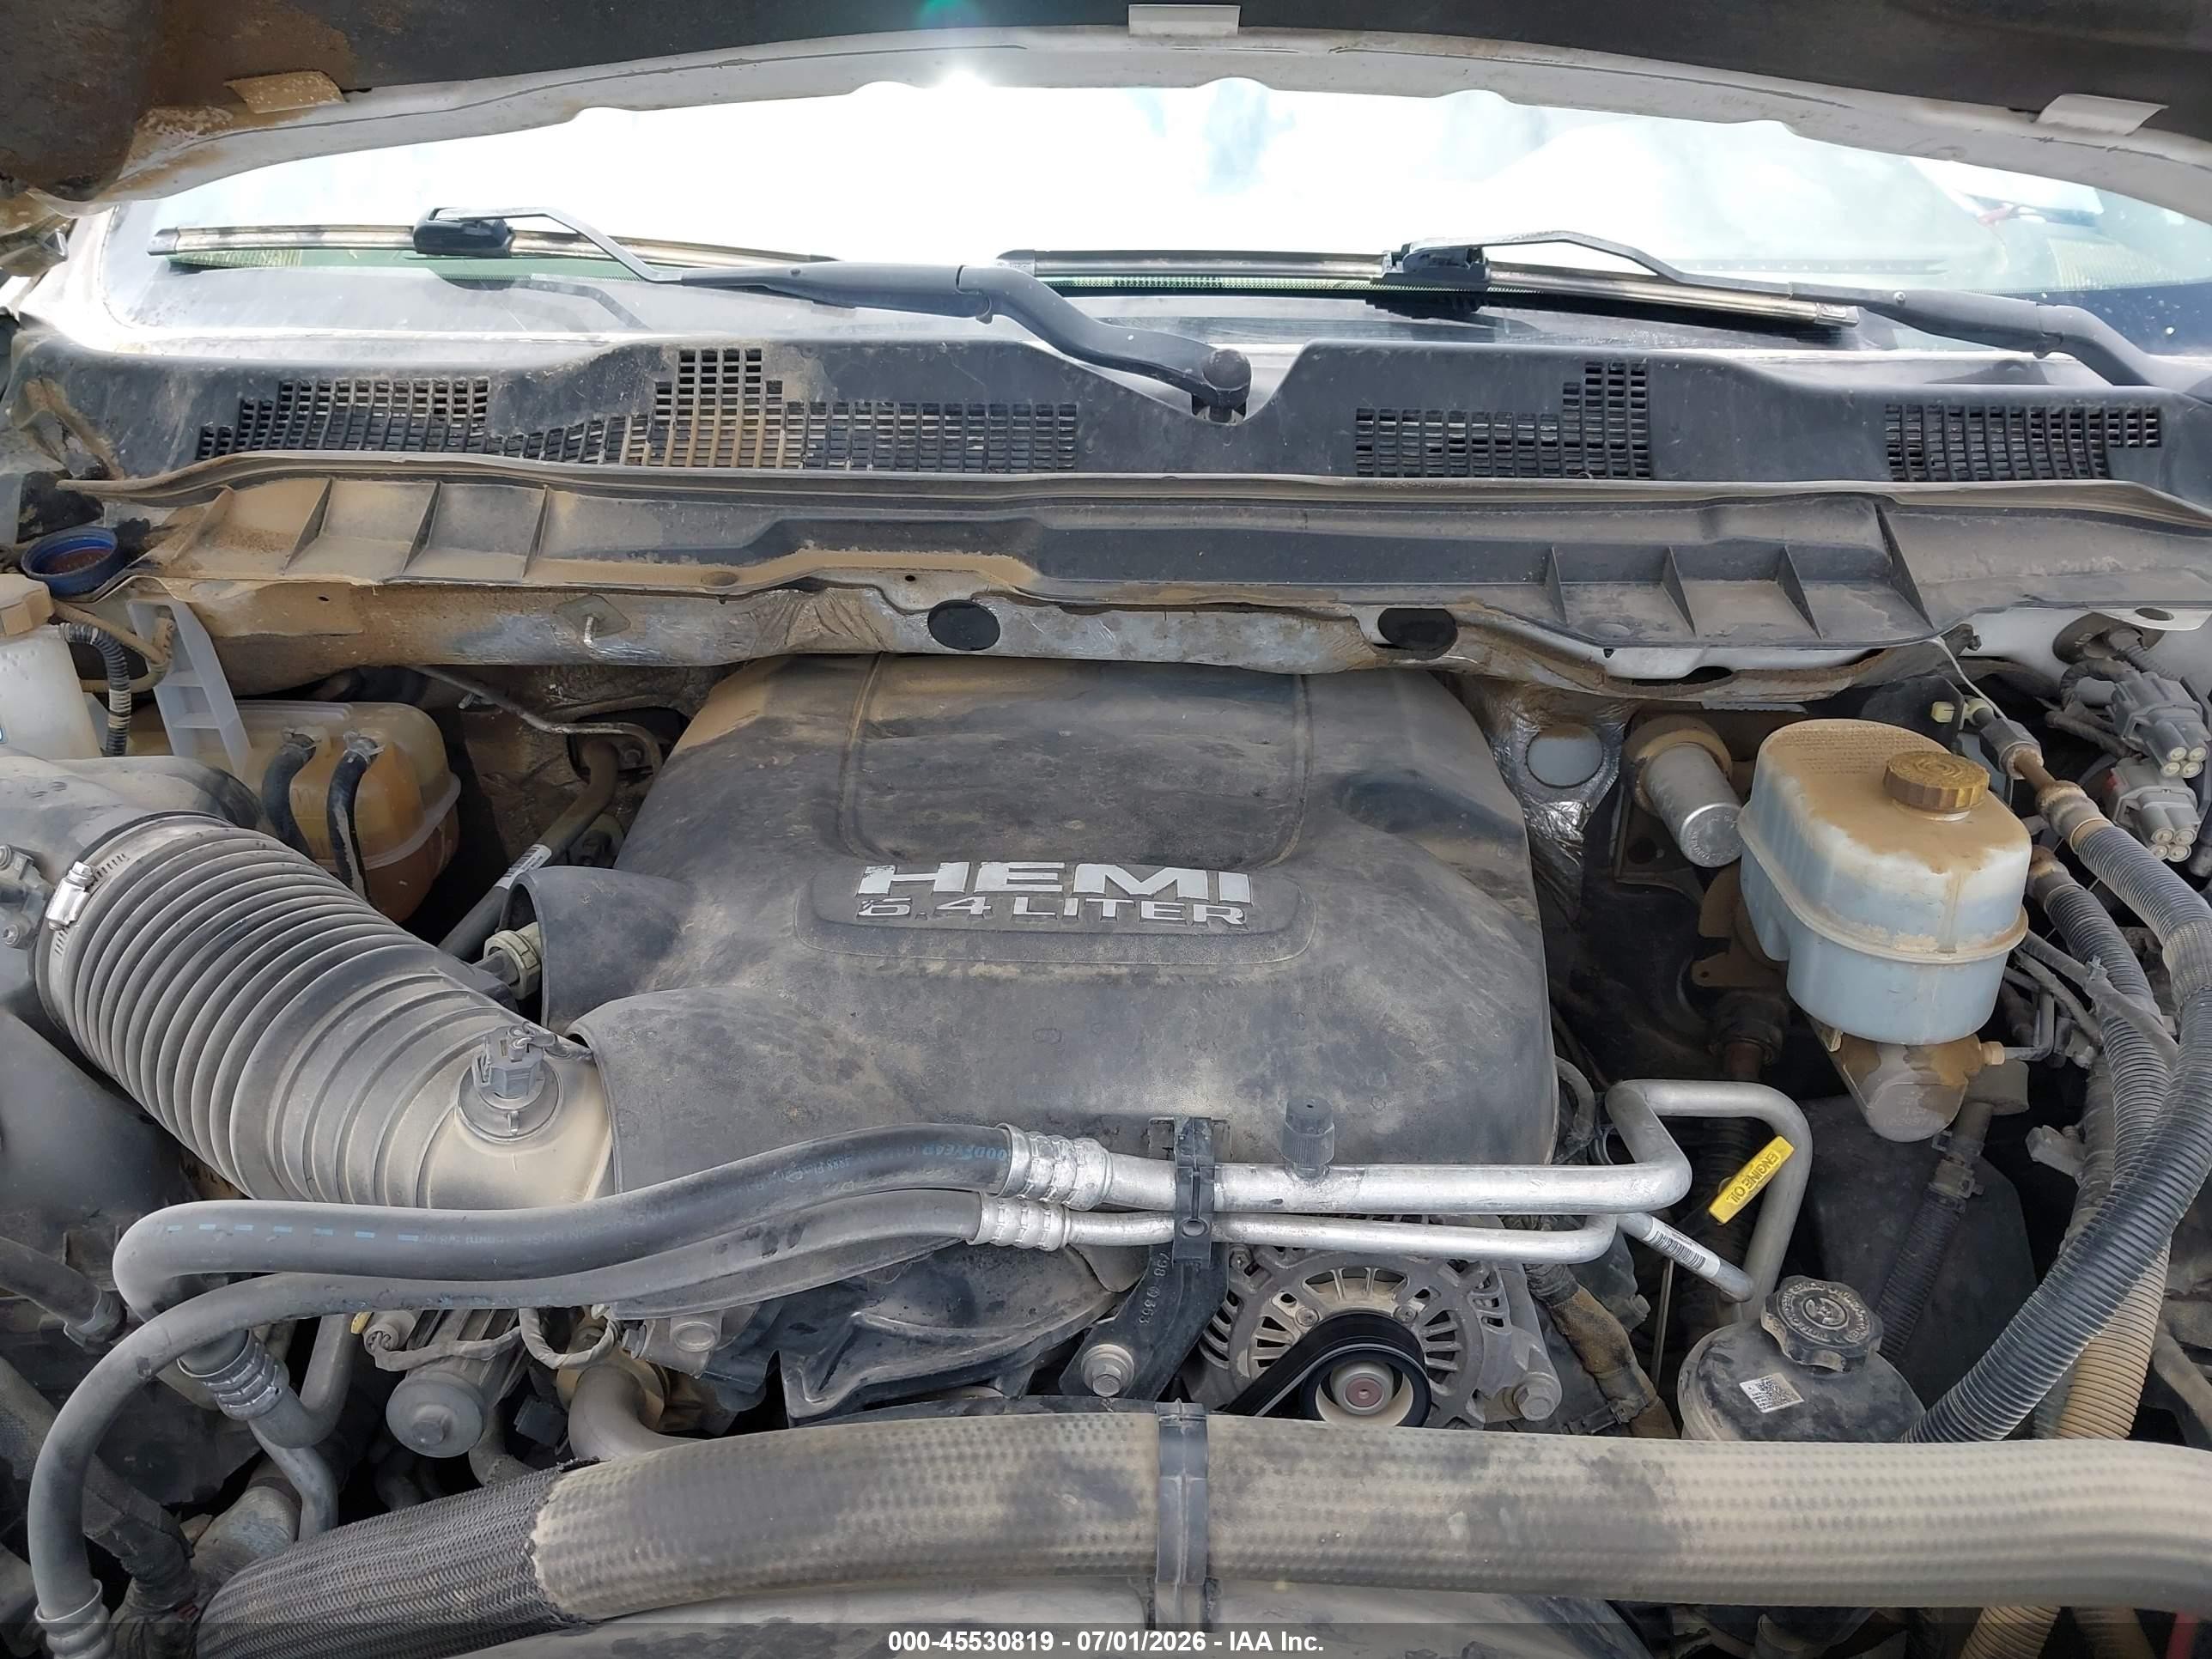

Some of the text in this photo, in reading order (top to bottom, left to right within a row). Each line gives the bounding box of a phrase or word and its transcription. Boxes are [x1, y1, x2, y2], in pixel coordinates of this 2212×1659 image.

[857, 861, 1252, 904] HEMI
[858, 896, 1249, 926] 6.4 LITER
[922, 1142, 1009, 1160] OODYEAR
[1725, 1151, 1780, 1204] ENGINE OIL
